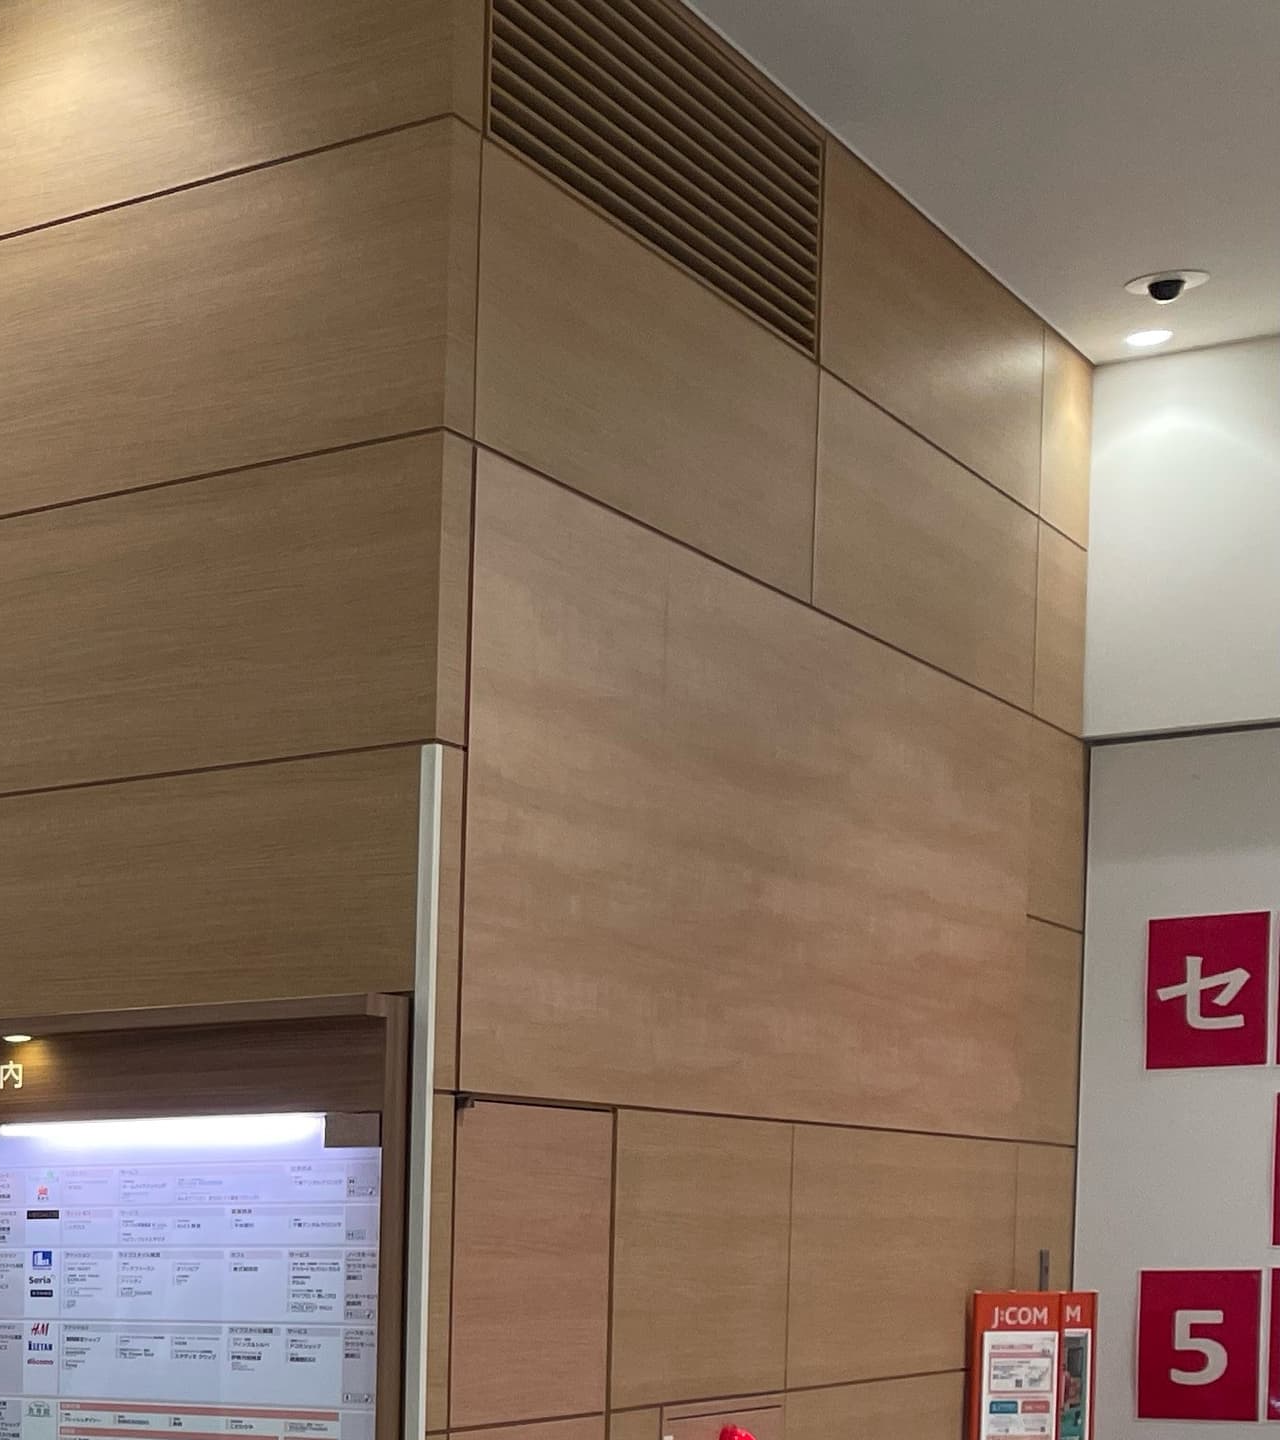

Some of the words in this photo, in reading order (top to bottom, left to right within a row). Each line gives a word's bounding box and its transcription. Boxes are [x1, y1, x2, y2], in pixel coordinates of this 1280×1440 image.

[1155, 955, 1253, 1030] セ
[28, 1275, 52, 1285] Seria
[991, 1306, 1049, 1328] J:COM
[1169, 1308, 1229, 1387] 5
